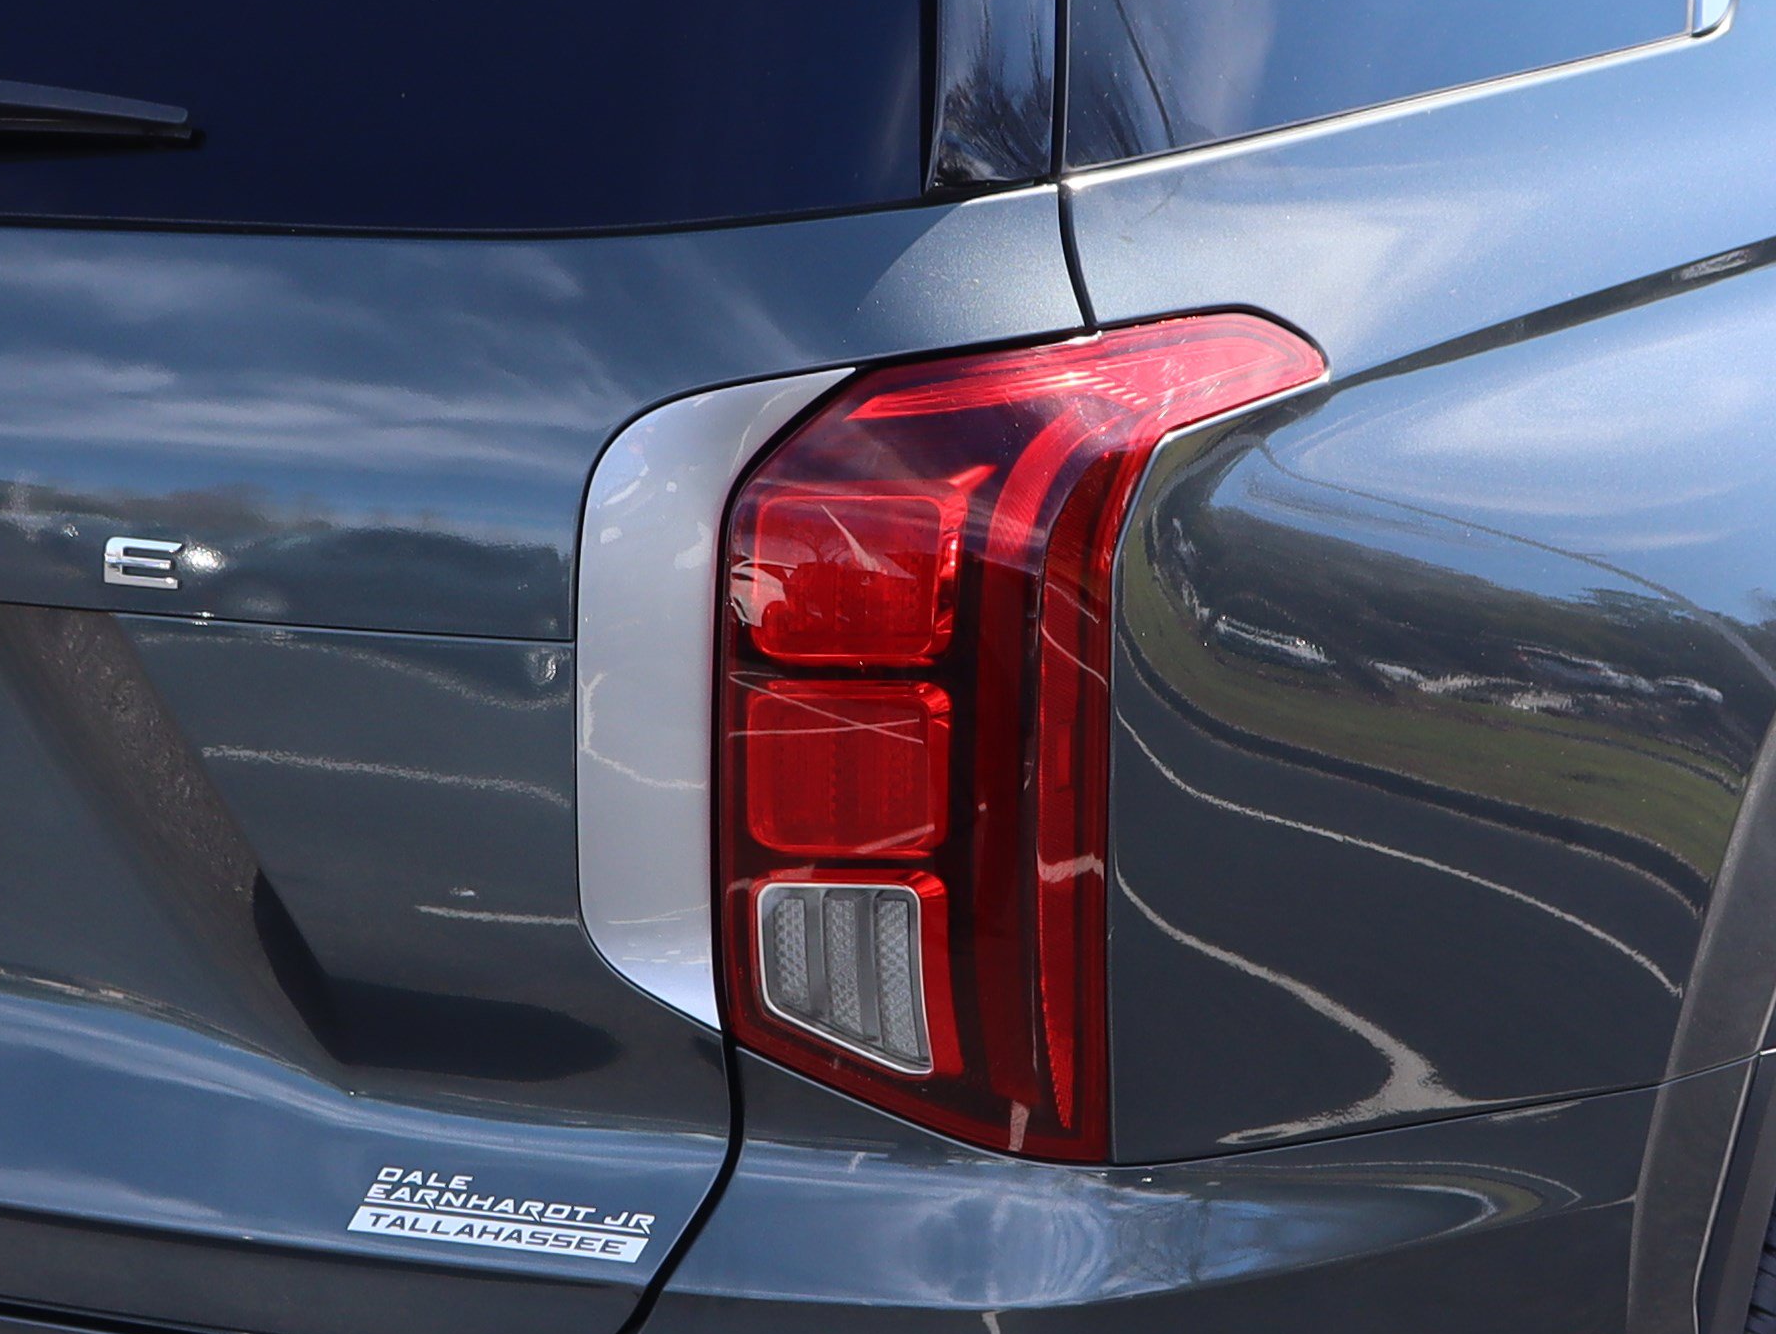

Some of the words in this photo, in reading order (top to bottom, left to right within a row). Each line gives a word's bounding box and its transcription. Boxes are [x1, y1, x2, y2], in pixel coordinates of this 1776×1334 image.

[377, 1167, 474, 1190] DALE
[367, 1183, 596, 1221] EARNHARDT
[603, 1213, 656, 1235] JR
[369, 1212, 627, 1255] TALLAHASSEE
